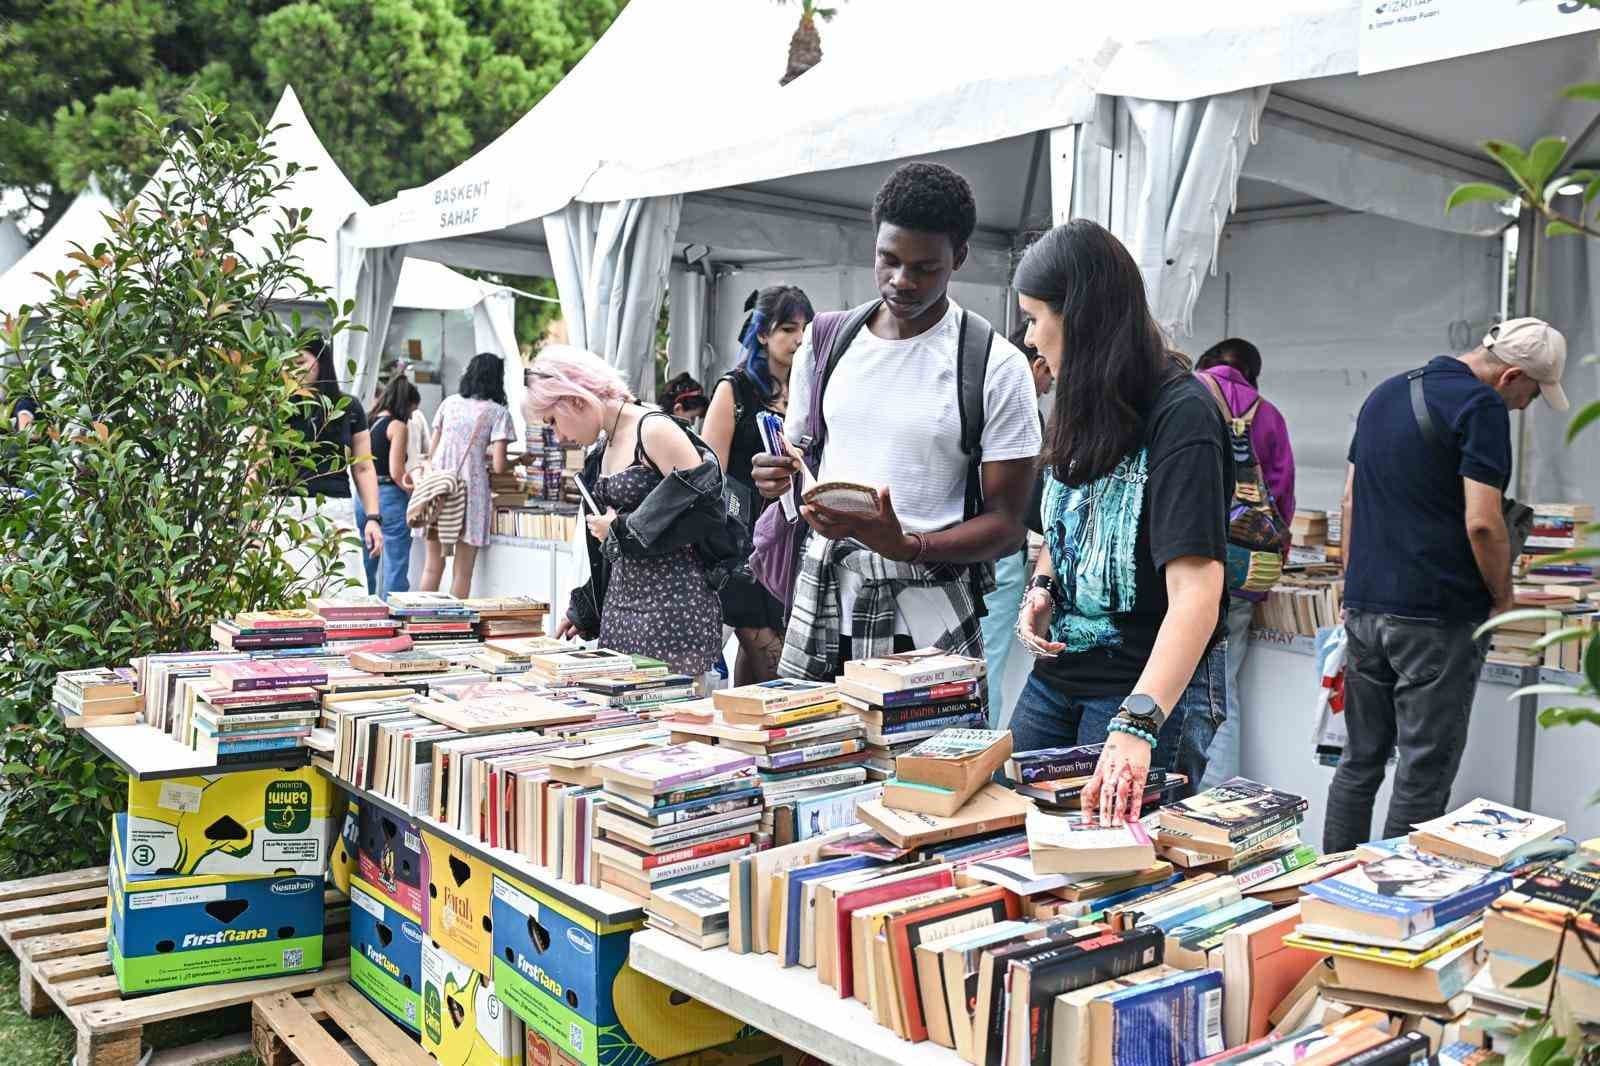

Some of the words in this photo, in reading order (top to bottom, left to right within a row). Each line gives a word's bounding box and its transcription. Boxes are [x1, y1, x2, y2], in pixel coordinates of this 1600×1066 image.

[434, 180, 490, 205] BAŞKENT
[440, 207, 479, 228] SAHAF
[1047, 762, 1075, 774] Thomas
[1075, 761, 1093, 772] Perry
[1251, 864, 1276, 880] CROSS
